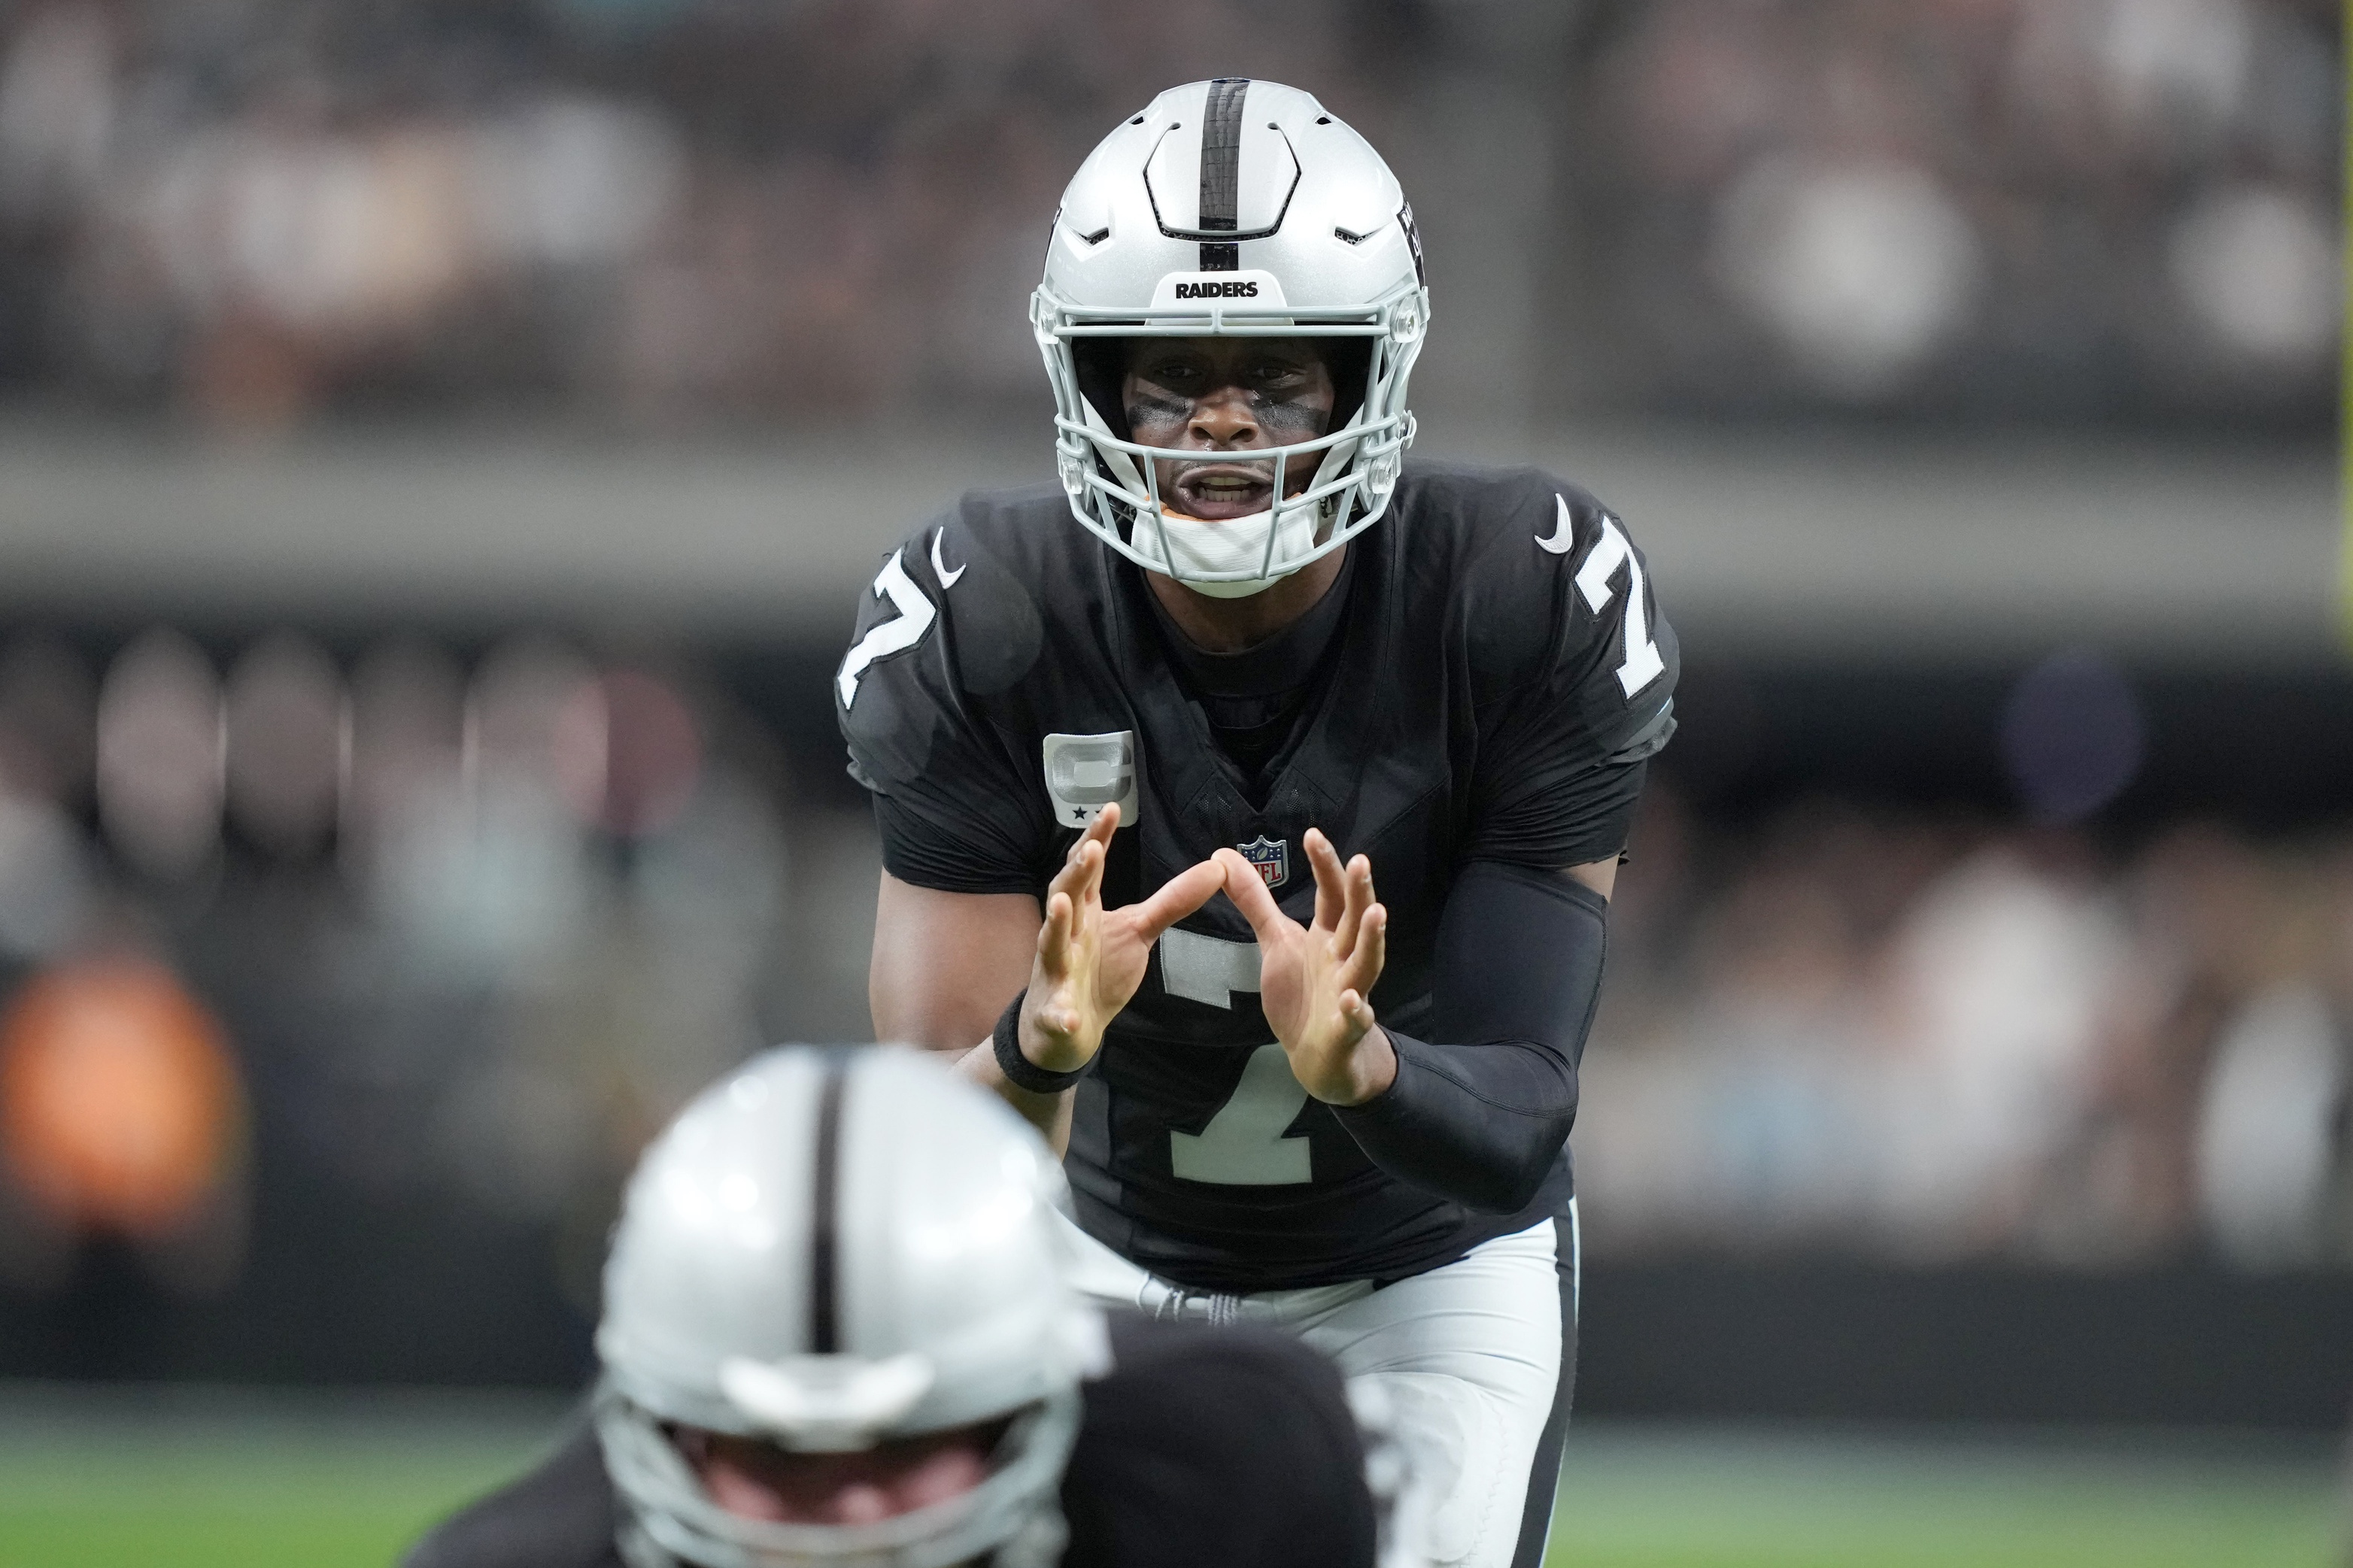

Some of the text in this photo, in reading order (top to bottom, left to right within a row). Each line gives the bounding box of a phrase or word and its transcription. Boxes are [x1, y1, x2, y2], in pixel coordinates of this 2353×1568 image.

[1176, 281, 1258, 299] RAIDERS
[837, 547, 937, 710] 7
[1574, 515, 1664, 699] 7
